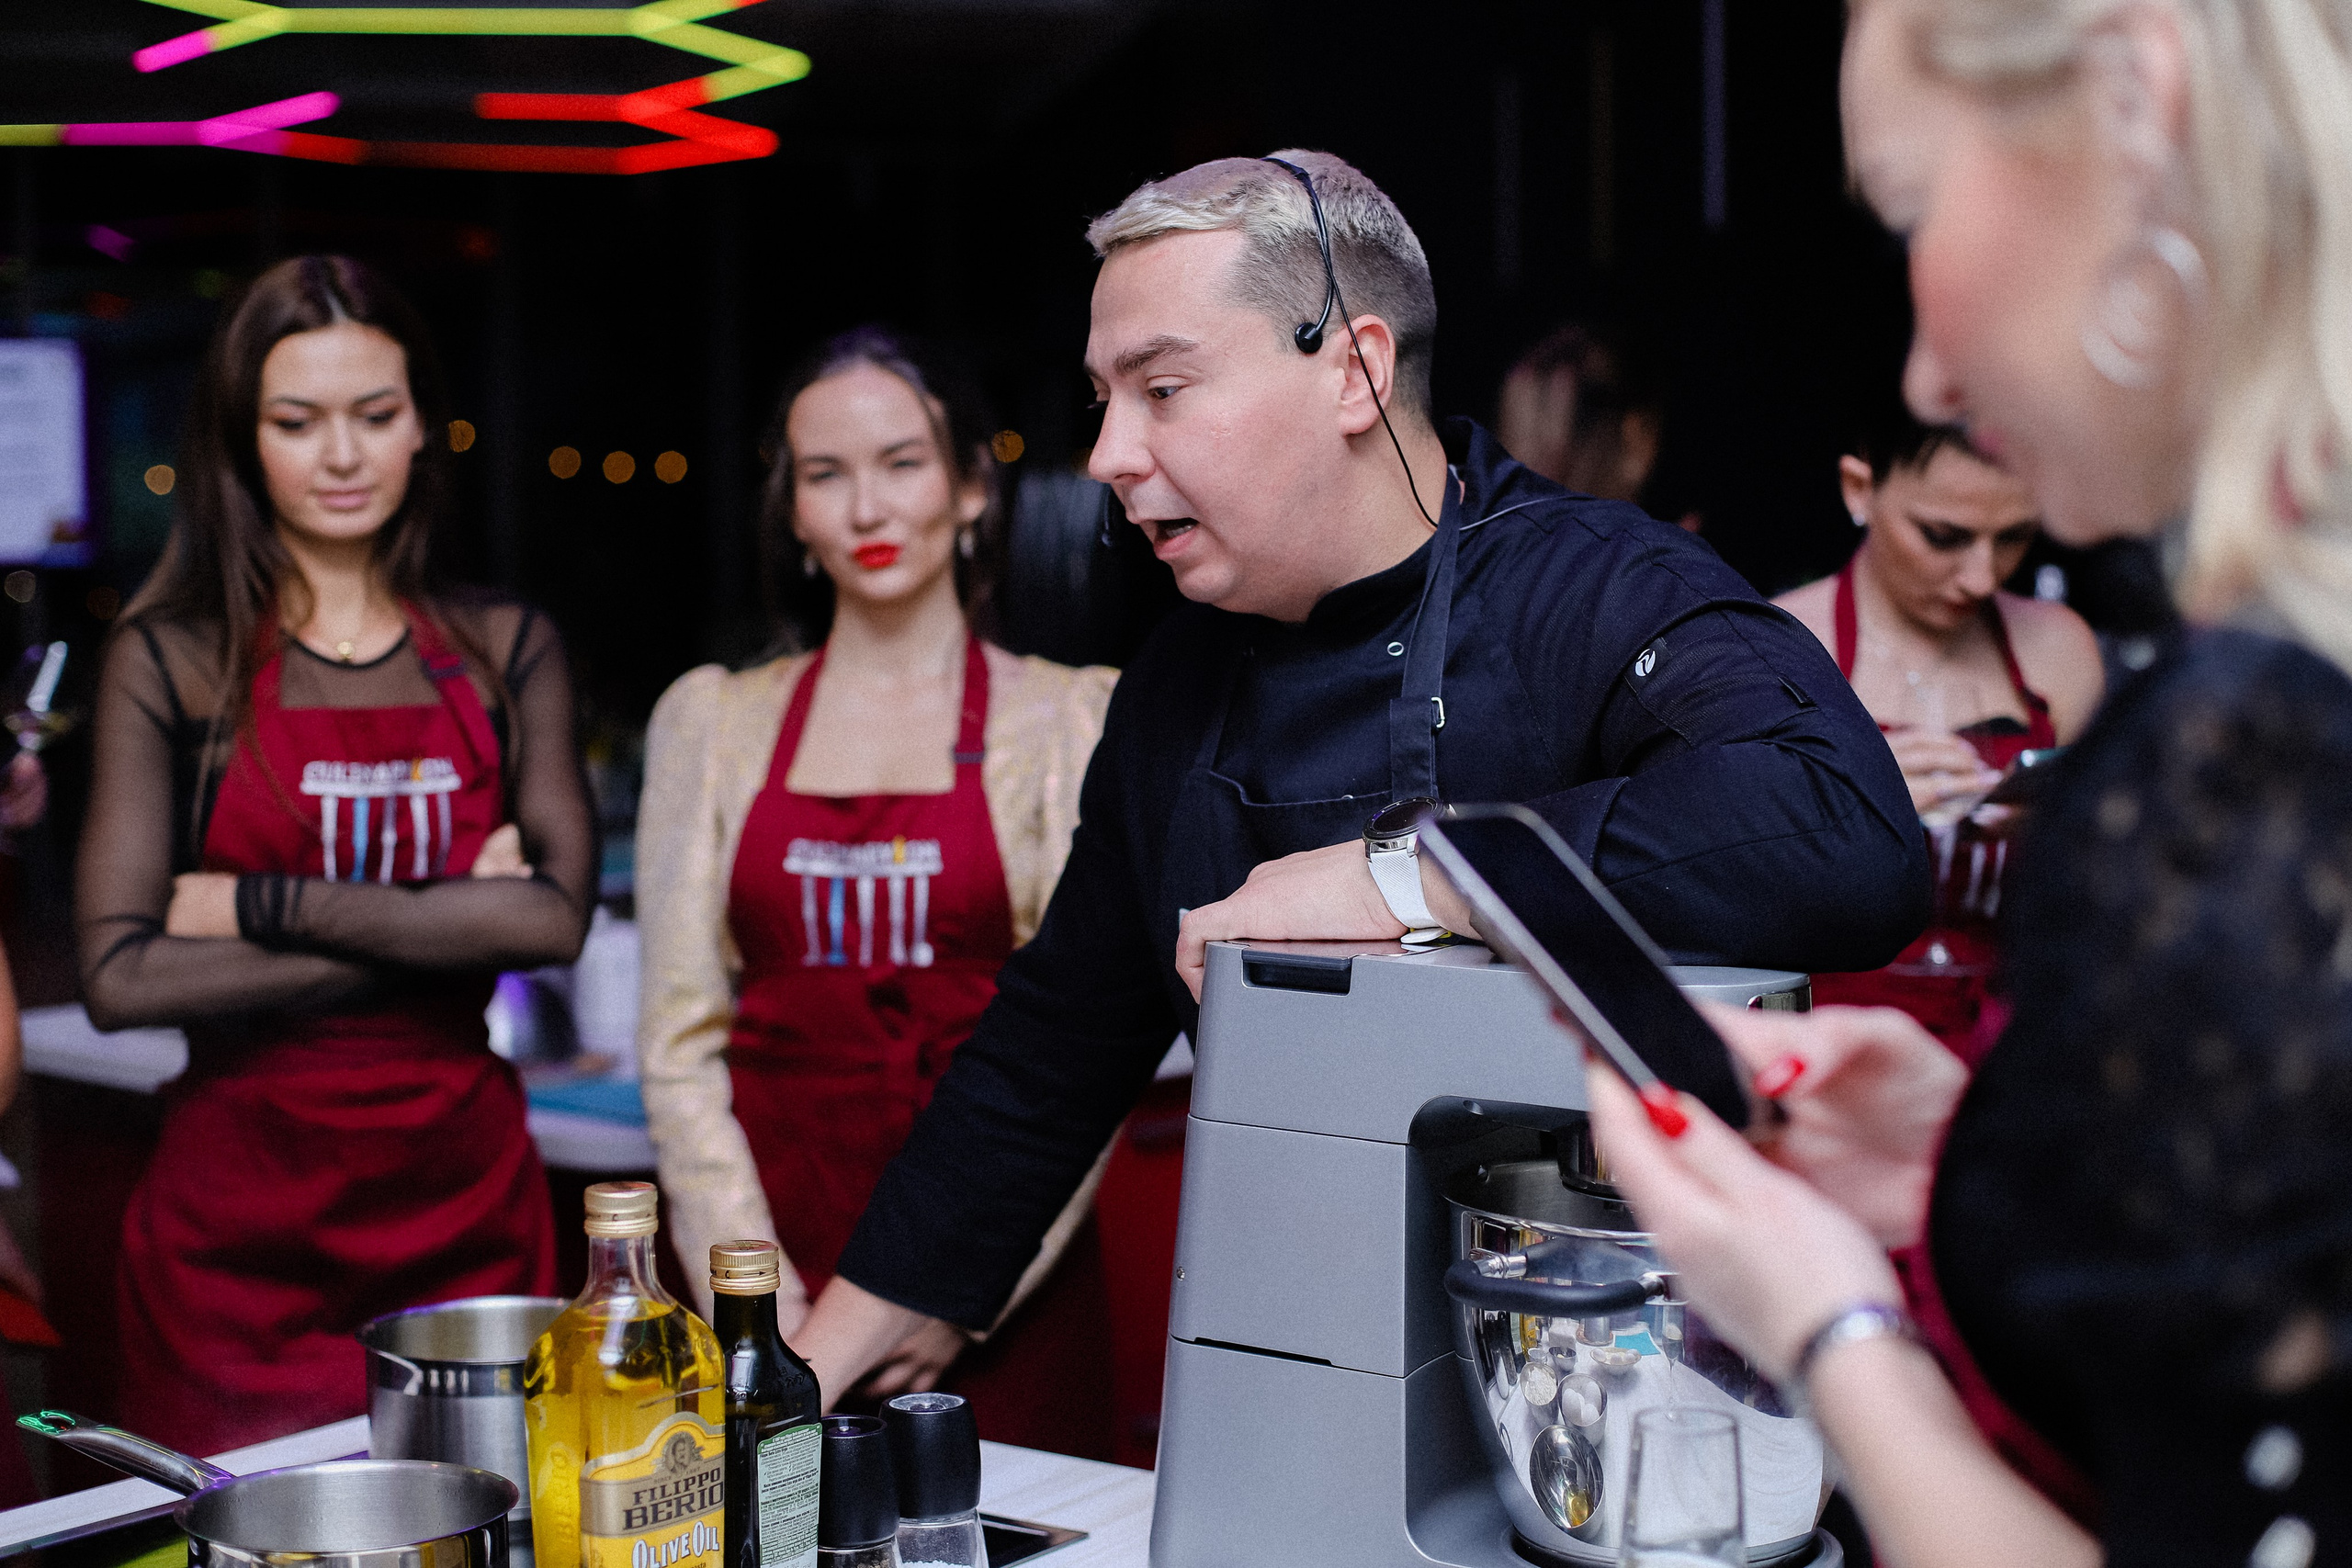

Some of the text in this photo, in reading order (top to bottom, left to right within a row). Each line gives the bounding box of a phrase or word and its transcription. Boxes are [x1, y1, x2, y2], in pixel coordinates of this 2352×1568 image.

[622, 1481, 724, 1530] BERIO
[633, 1467, 720, 1506] FILIPPO
[632, 1532, 691, 1568] OLIVE
[692, 1520, 720, 1558] OIL
